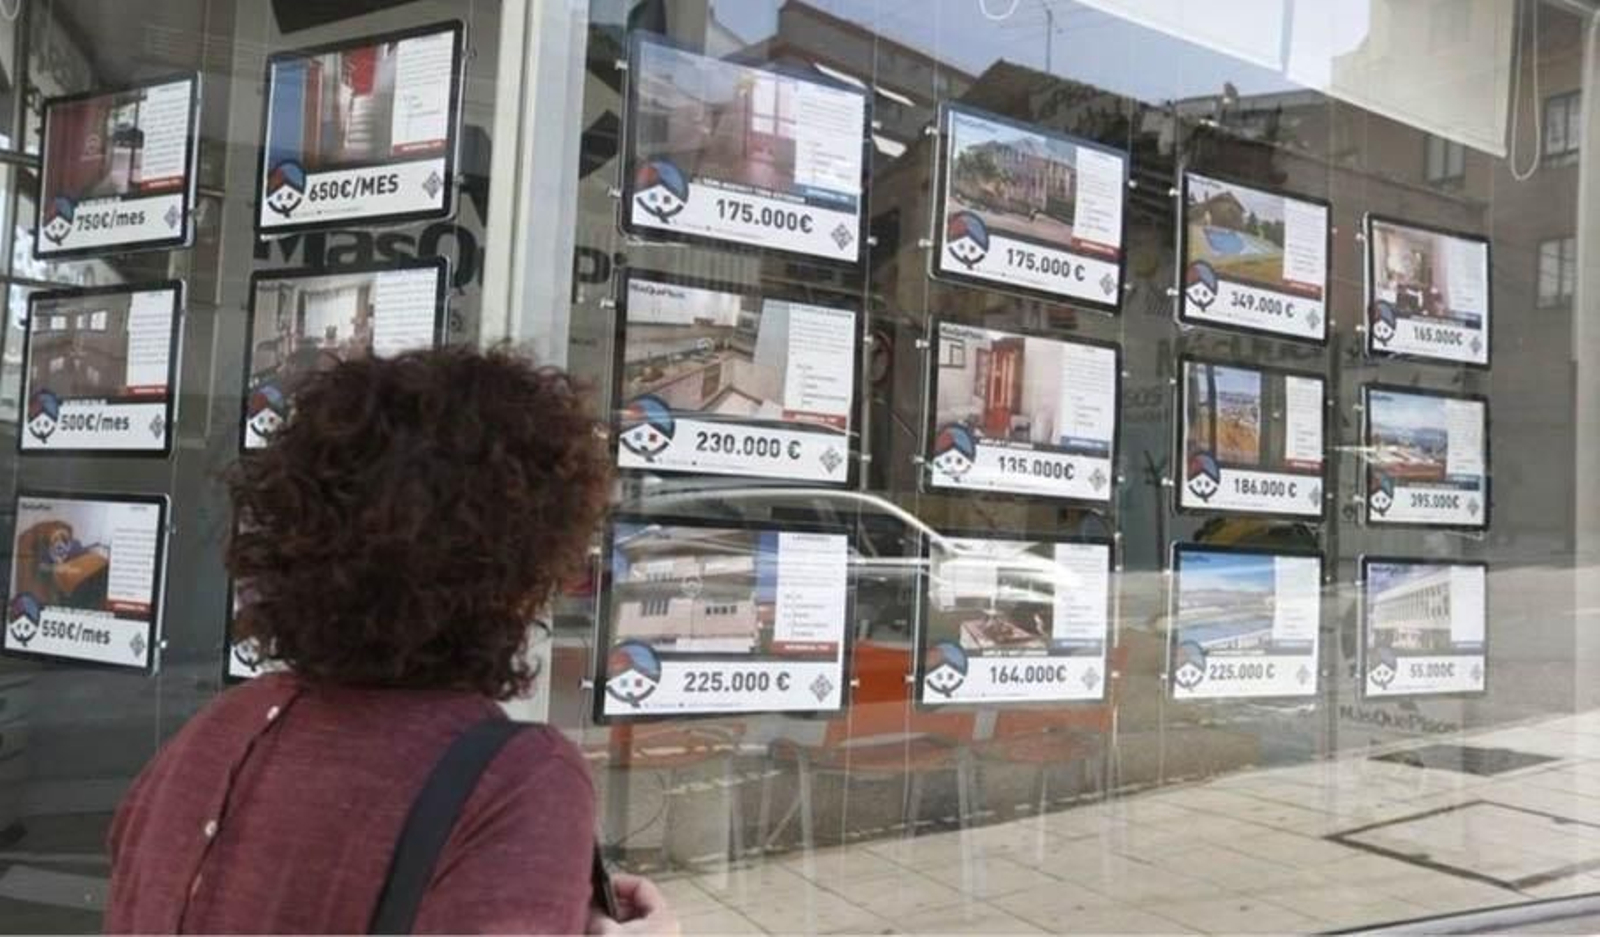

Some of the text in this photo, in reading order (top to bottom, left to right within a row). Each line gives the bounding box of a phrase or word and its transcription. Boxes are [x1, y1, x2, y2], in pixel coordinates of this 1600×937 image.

[309, 172, 399, 203] 650€/MES
[76, 209, 146, 232] 750€/mes
[716, 199, 813, 234] 175.000€
[1006, 247, 1071, 278] 175.000
[1230, 291, 1283, 316] 349.000
[60, 412, 130, 432] 500€/mes
[696, 431, 781, 459] 230.000
[1234, 478, 1285, 498] 186.000
[41, 619, 111, 645] 550€/mes
[683, 672, 770, 693] 225.000
[990, 665, 1067, 684] 164.000€
[1209, 664, 1264, 681] 225.000
